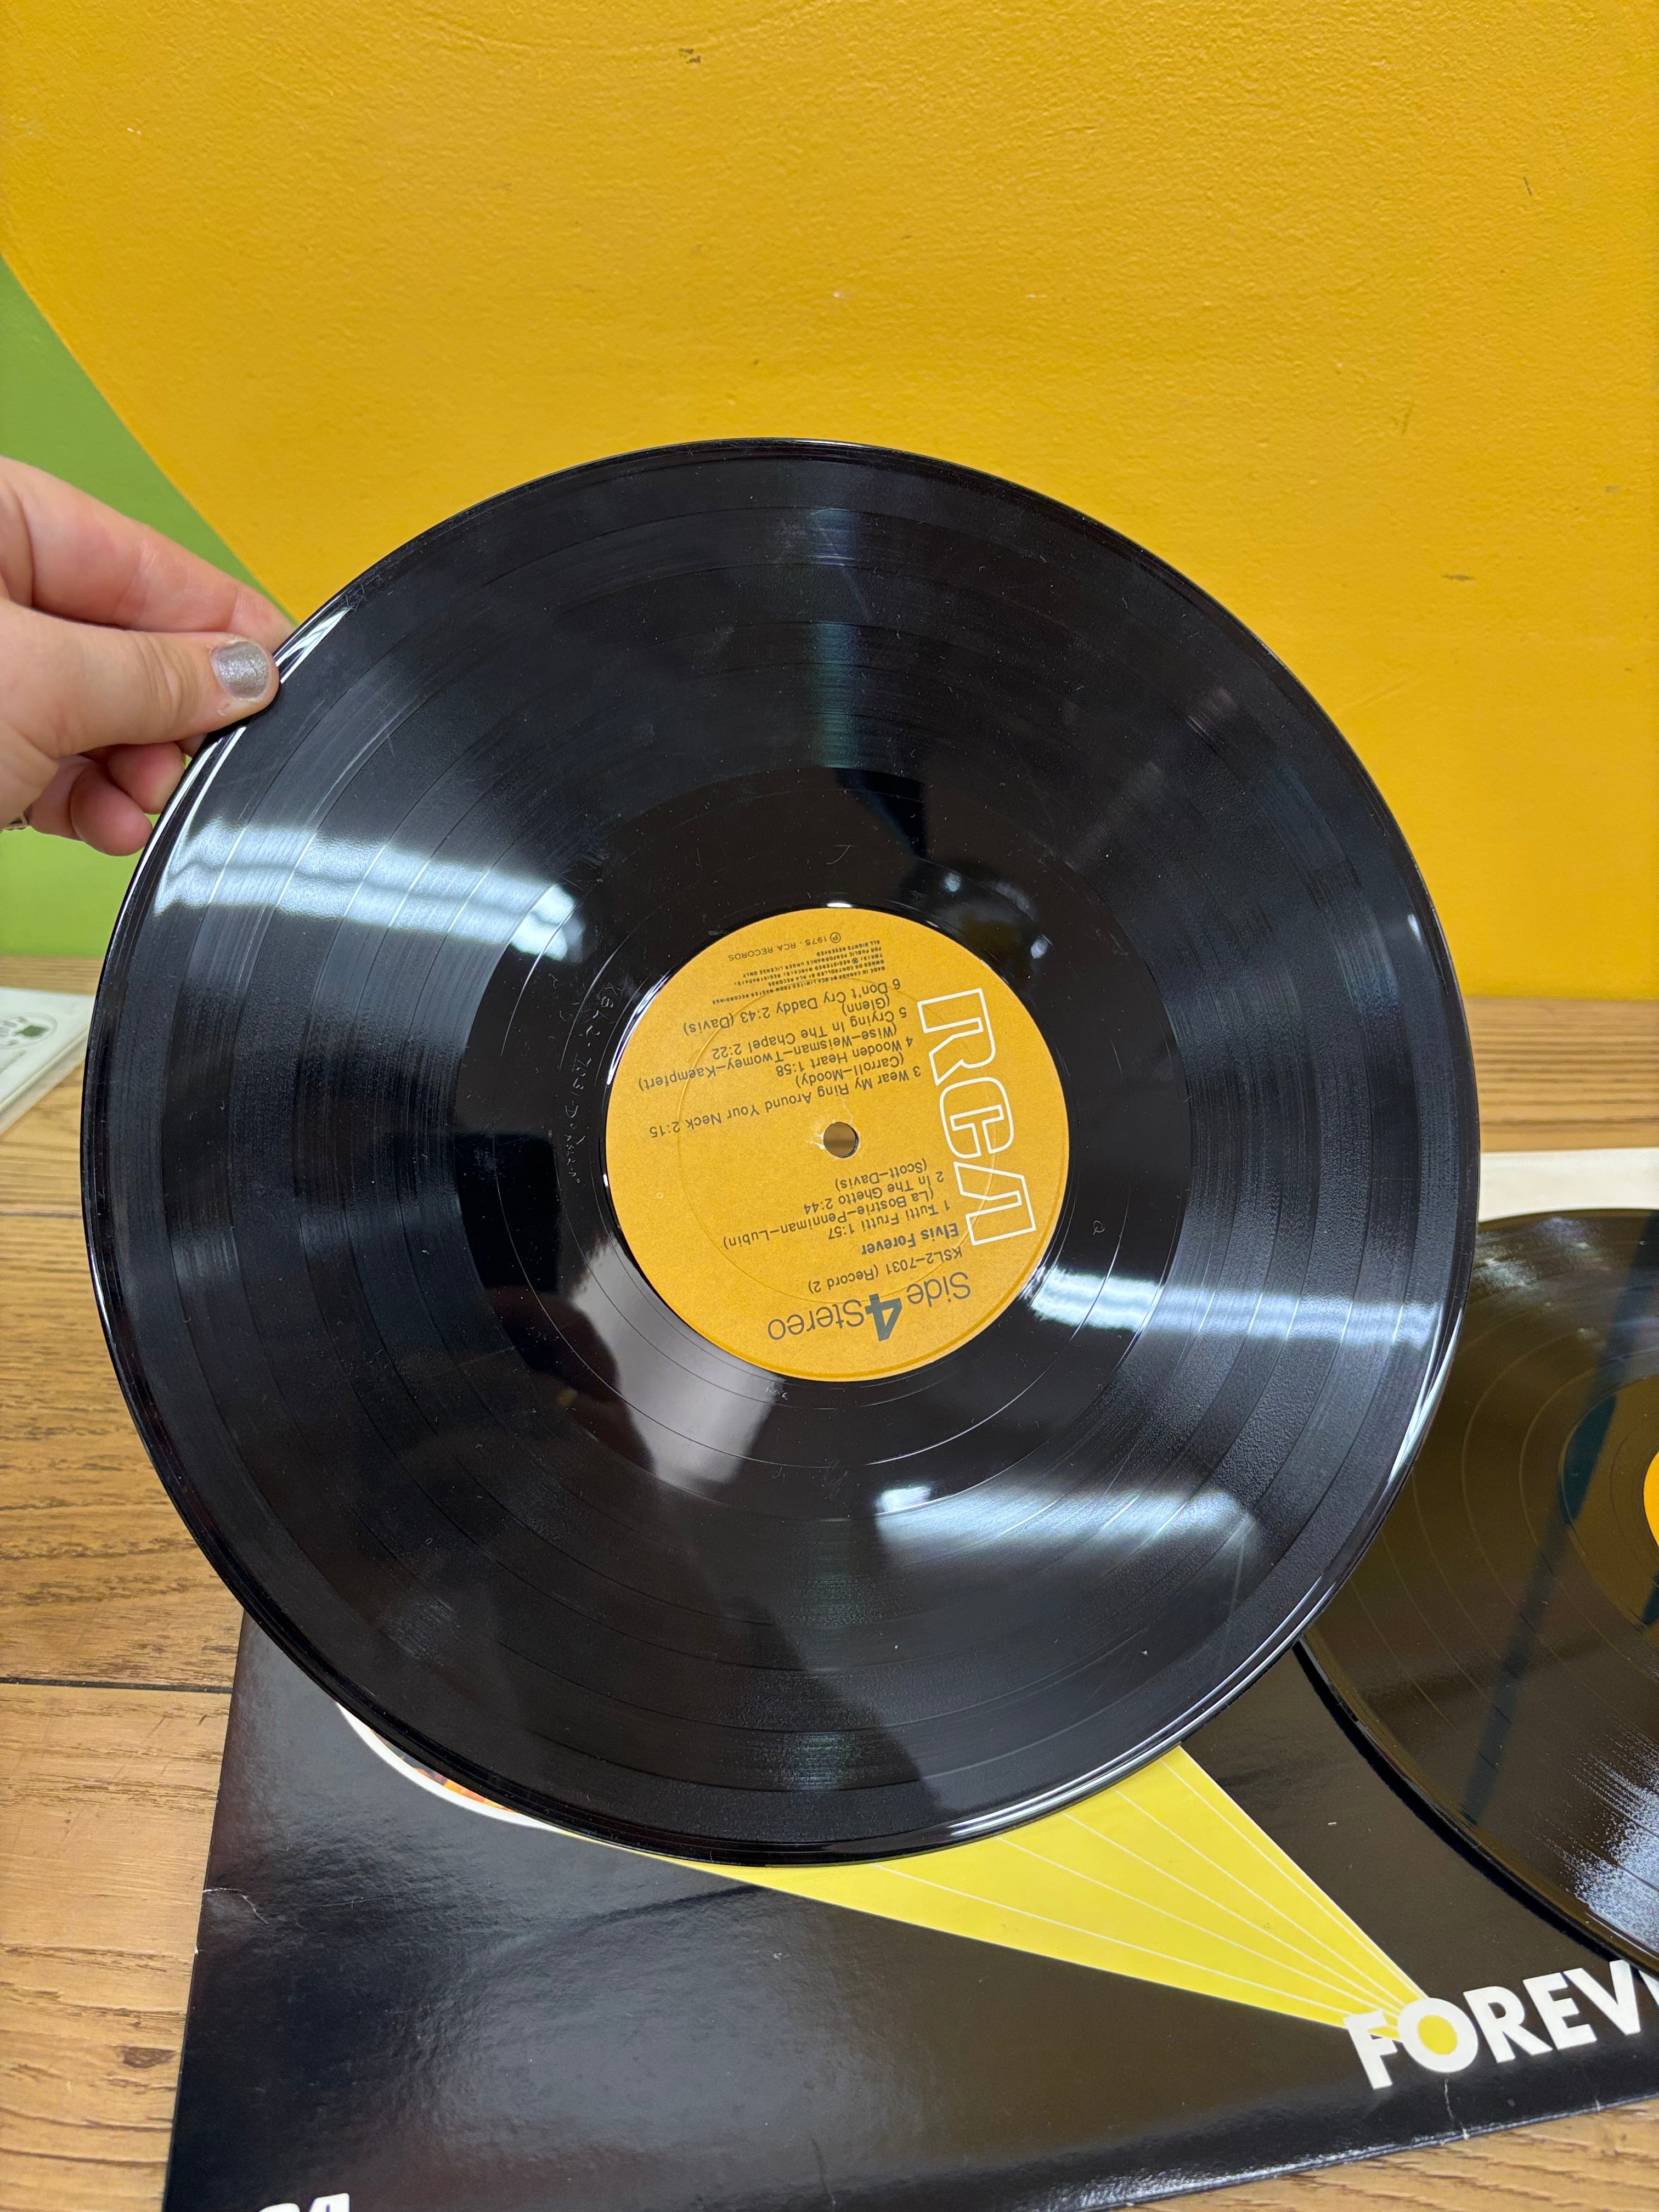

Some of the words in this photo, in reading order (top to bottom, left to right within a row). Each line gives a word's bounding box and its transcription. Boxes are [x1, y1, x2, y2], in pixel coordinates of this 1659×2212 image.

[776, 942, 797, 951] RCA
[805, 935, 827, 946] 1975
[847, 942, 868, 951] RIGHTS
[728, 946, 774, 961] RECORDS
[806, 953, 848, 966] PERFORMANCE
[816, 947, 846, 957] RESERVED
[849, 949, 869, 957] PUBLIC
[759, 966, 783, 975] LICENSE
[785, 962, 805, 970] UNDER
[814, 960, 850, 970] REGISTERED
[864, 959, 884, 968] OWNED
[816, 966, 854, 977] CONTROLLED
[838, 970, 861, 980] CANADA
[768, 978, 794, 987] RECORDS
[791, 979, 816, 989] LIMITED
[892, 978, 901, 990] 6
[751, 989, 774, 997] MASTER
[823, 991, 847, 1004] Cry
[851, 982, 888, 1000] Don't
[712, 994, 749, 1005] RECORDINGS
[776, 997, 819, 1015] Daddy
[842, 992, 890, 1017] (Glenn)
[740, 1007, 770, 1024] 2:43
[849, 1010, 895, 1028] Crying
[899, 1007, 907, 1019] 5
[683, 1012, 734, 1036] (Davis)
[832, 1022, 845, 1033] In
[800, 1026, 828, 1039] The
[748, 1032, 795, 1053] Chapel
[851, 1040, 902, 1058] Wooden
[905, 1036, 913, 1048] 4
[712, 1043, 742, 1060] 2:22
[810, 1051, 848, 1069] Heart
[775, 1061, 805, 1077] 1:58
[912, 1065, 921, 1077] 3
[855, 1076, 873, 1091] My
[877, 1069, 910, 1085] Wear
[817, 1083, 849, 1098] Ring
[764, 1091, 812, 1113] Around
[726, 1104, 760, 1119] Your
[917, 988, 1036, 1246] RCA
[685, 1112, 722, 1130] Neck
[649, 1121, 680, 1138] 2:15
[918, 1175, 932, 1188] In
[935, 1171, 944, 1183] 2
[887, 1180, 914, 1193] The
[909, 1185, 934, 1202] (La
[838, 1187, 883, 1205] Ghetto
[803, 1198, 833, 1215] 2:44
[905, 1204, 939, 1221] Tutti
[944, 1200, 951, 1211] 1
[861, 1212, 900, 1232] Frutti
[828, 1223, 855, 1240] 1:57
[920, 1222, 960, 1242] Elvis
[861, 1233, 917, 1255] Forever
[826, 1263, 879, 1291] (Record
[808, 1280, 821, 1295] 2)
[904, 1272, 971, 1308] Side
[768, 1299, 865, 1340] Stereo
[864, 1290, 902, 1342] 4
[1344, 1959, 1659, 2090] FOREV
